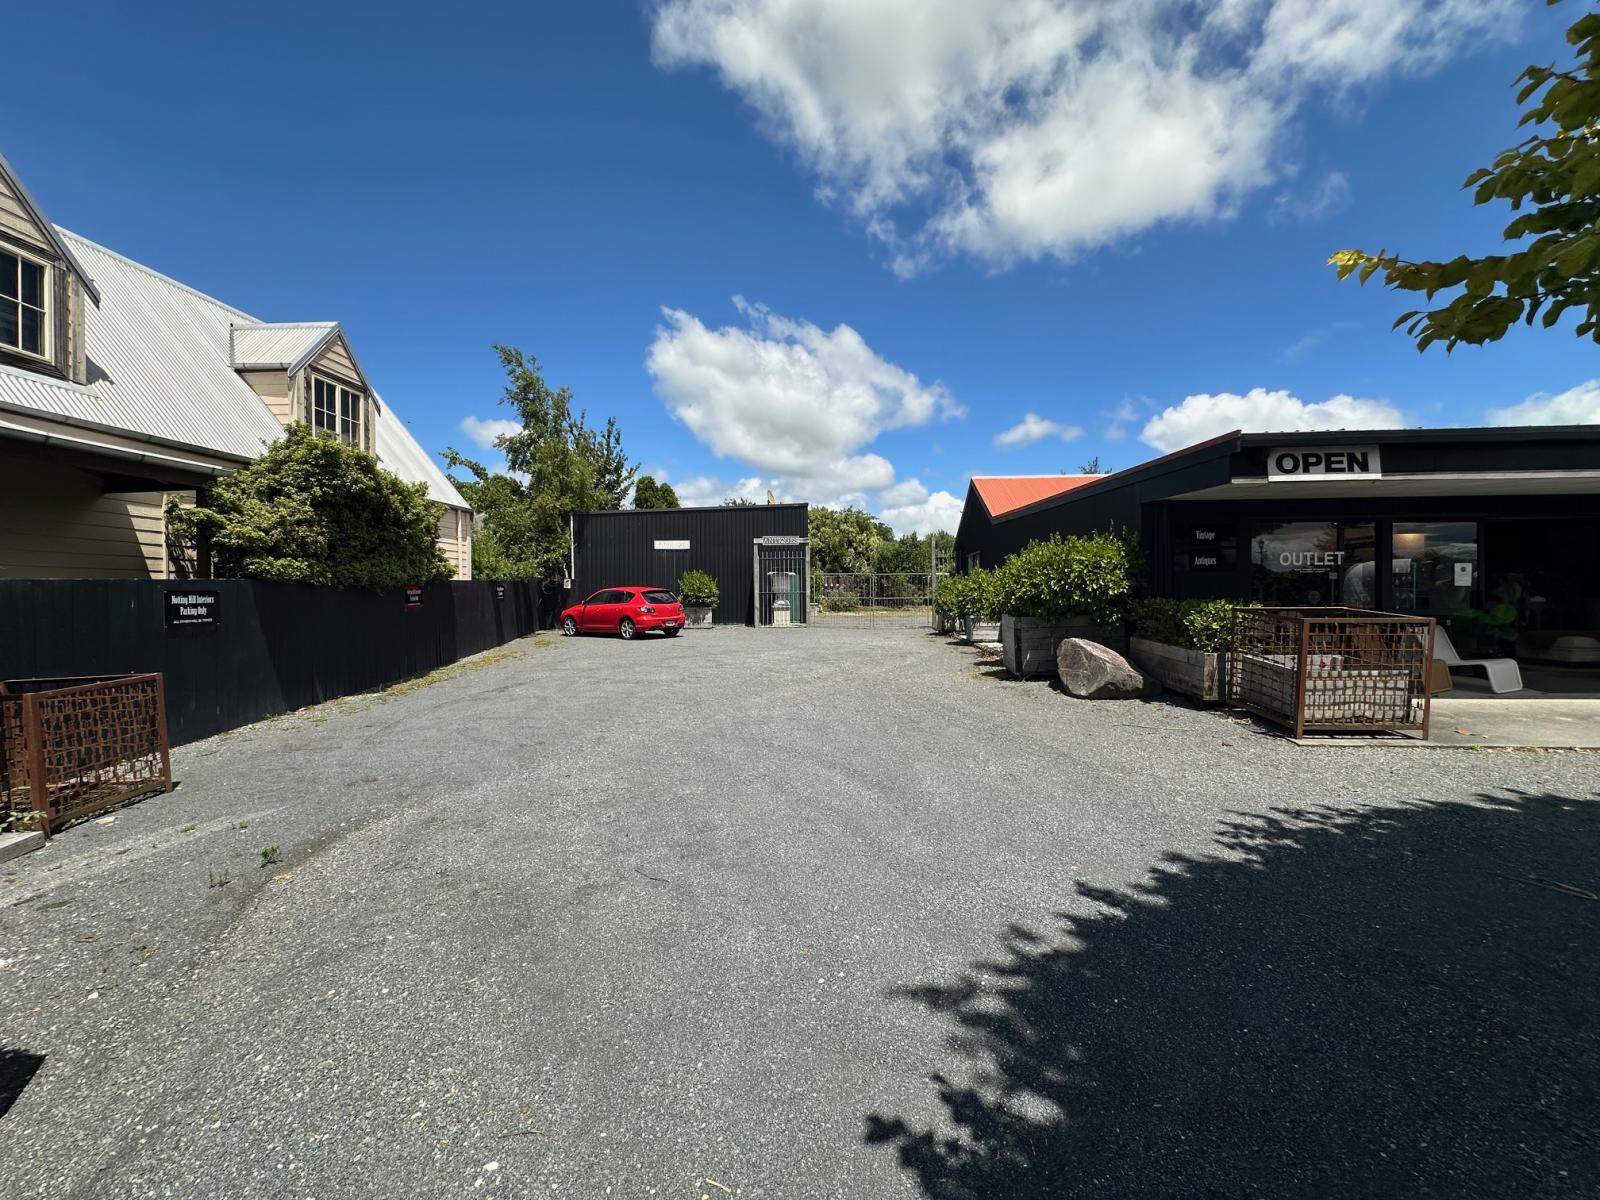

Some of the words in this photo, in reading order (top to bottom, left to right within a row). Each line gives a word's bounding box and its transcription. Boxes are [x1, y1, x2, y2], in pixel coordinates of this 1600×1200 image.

[1276, 452, 1369, 473] OPEN
[1196, 530, 1215, 540] Vintage
[1195, 555, 1216, 566] Antiques
[1280, 552, 1344, 565] OUTLET
[171, 595, 188, 605] Notting
[188, 595, 197, 604] Hill
[197, 595, 214, 604] Interiors
[180, 606, 197, 616] Parking
[198, 606, 207, 615] Only
